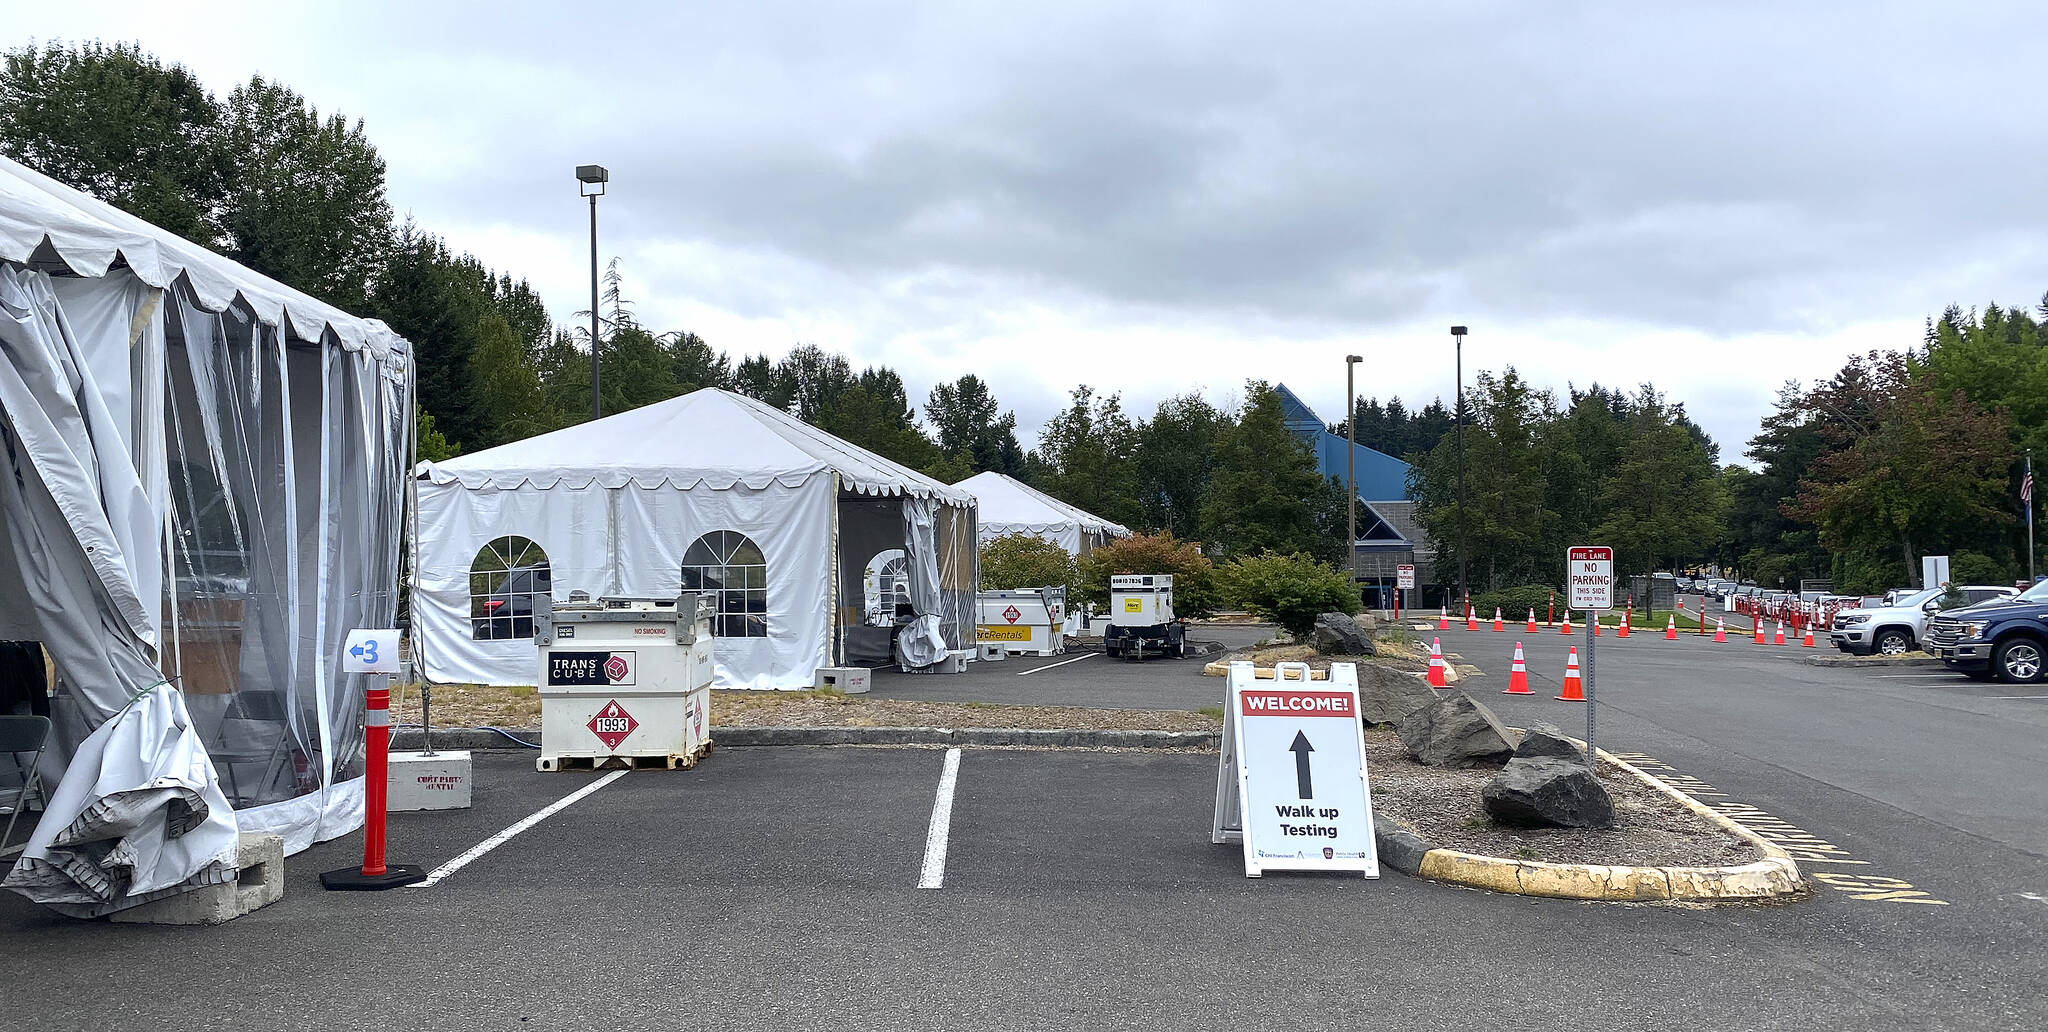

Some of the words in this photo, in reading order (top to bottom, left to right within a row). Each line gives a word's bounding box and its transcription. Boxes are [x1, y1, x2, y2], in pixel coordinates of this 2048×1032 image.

[1572, 552, 1588, 560] FIRE
[1589, 552, 1607, 560] LANE
[1584, 562, 1598, 573] NO
[1572, 575, 1610, 586] PARKING
[1576, 587, 1590, 595] THIS
[1592, 587, 1606, 595] SIDE
[977, 630, 1023, 640] ercRentals
[363, 640, 379, 664] 3
[553, 659, 597, 669] TRANS
[553, 669, 596, 678] CUBE
[1246, 696, 1349, 711] WELCOME!
[598, 718, 627, 732] 1993
[609, 738, 616, 746] 3
[1275, 805, 1316, 818] Walk
[1319, 808, 1339, 820] up
[1280, 824, 1338, 839] Testing
